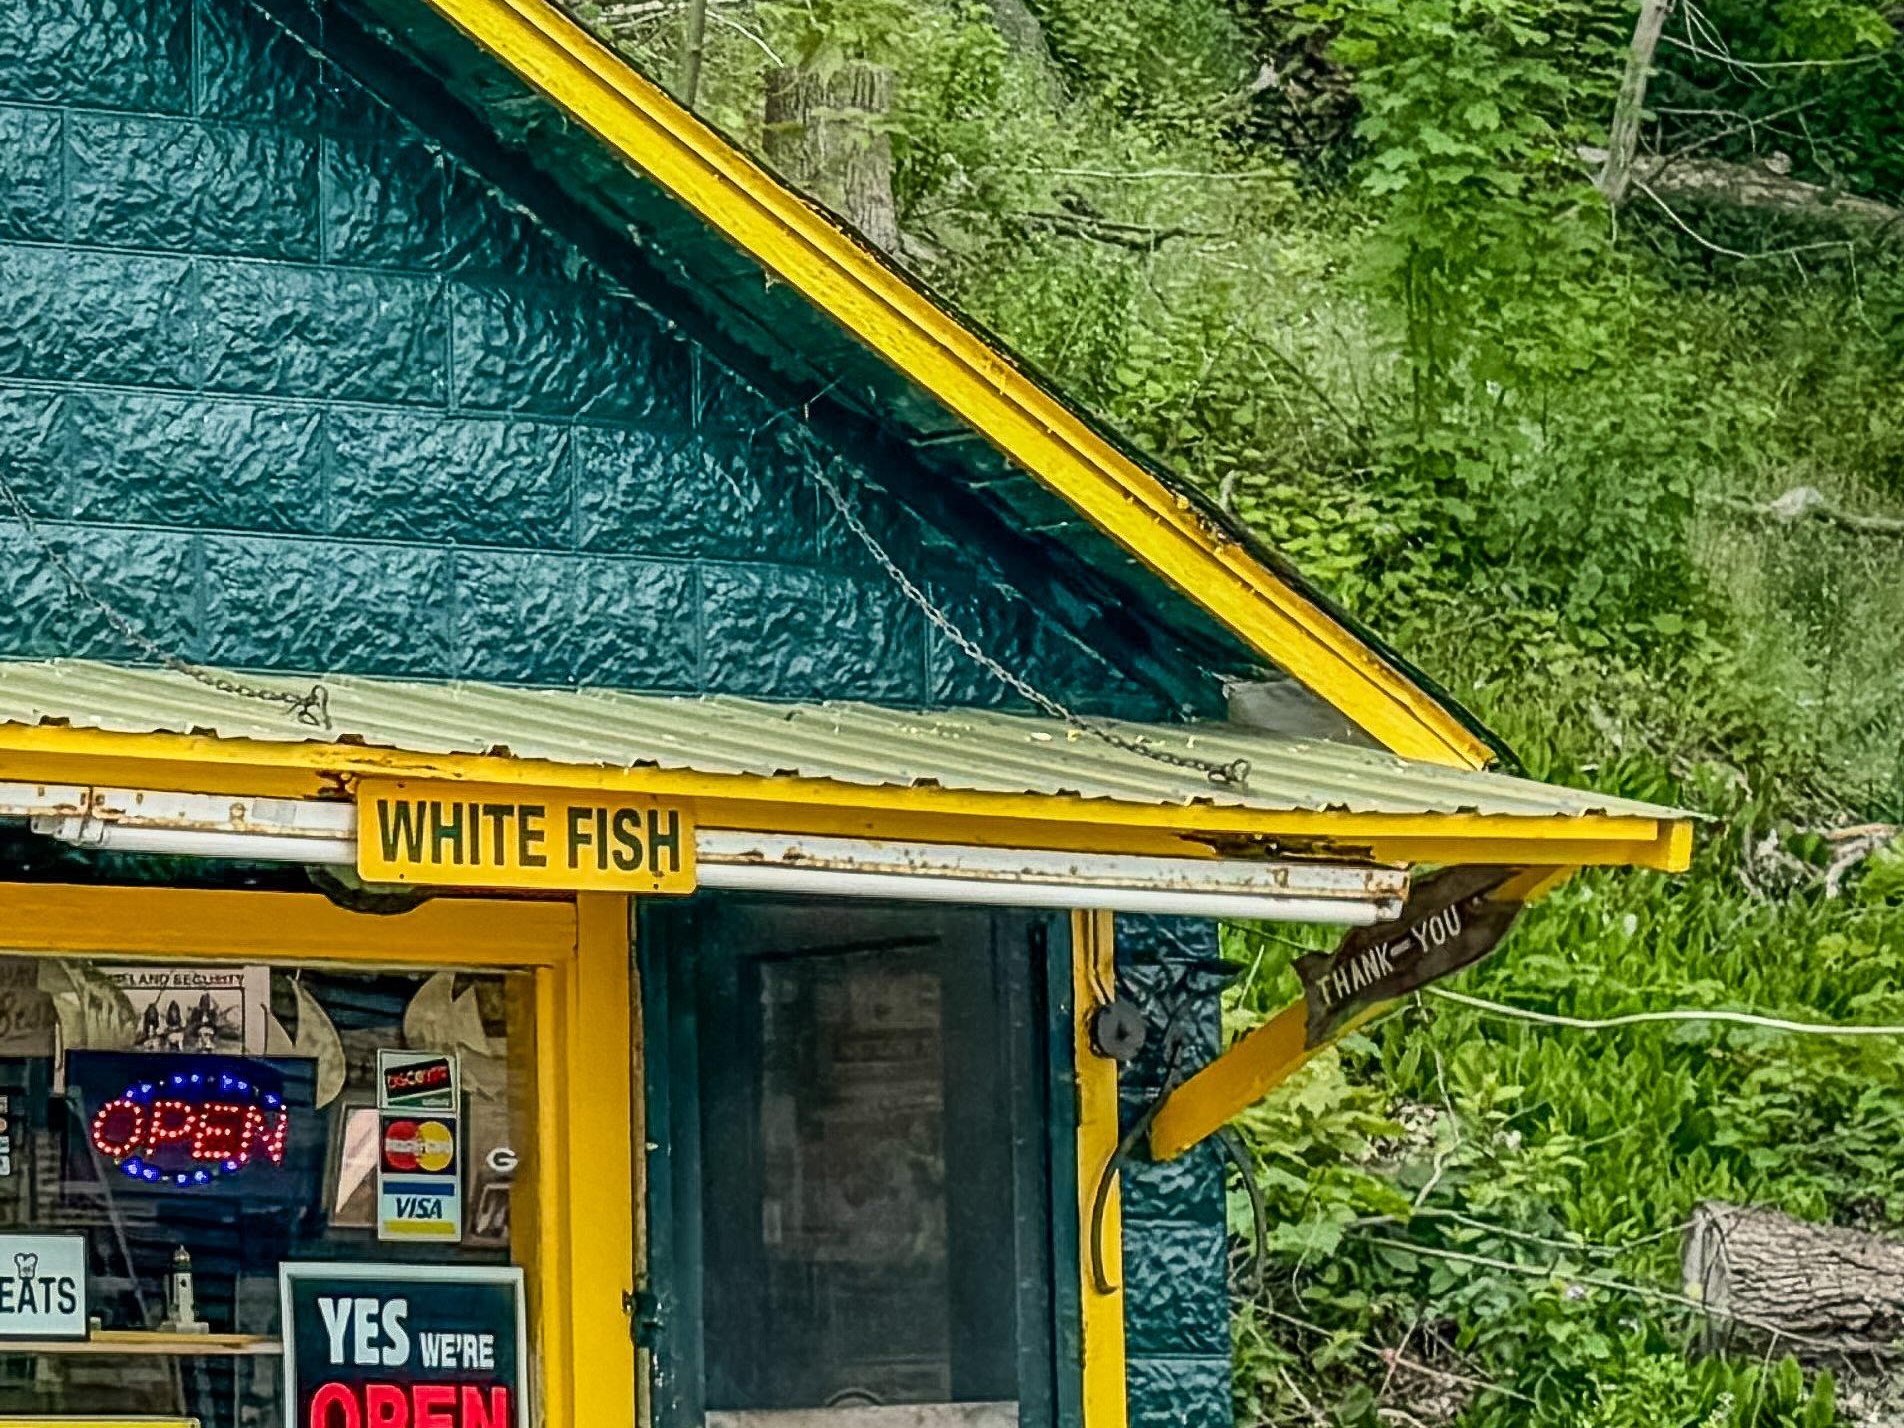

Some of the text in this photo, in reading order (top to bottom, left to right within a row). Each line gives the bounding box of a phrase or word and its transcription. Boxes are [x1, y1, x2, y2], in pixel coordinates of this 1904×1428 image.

[377, 799, 683, 876] WHITE FISH
[91, 1098, 288, 1166] OPEN
[396, 1197, 443, 1220] VISA
[318, 1297, 495, 1370] YES WE'RE
